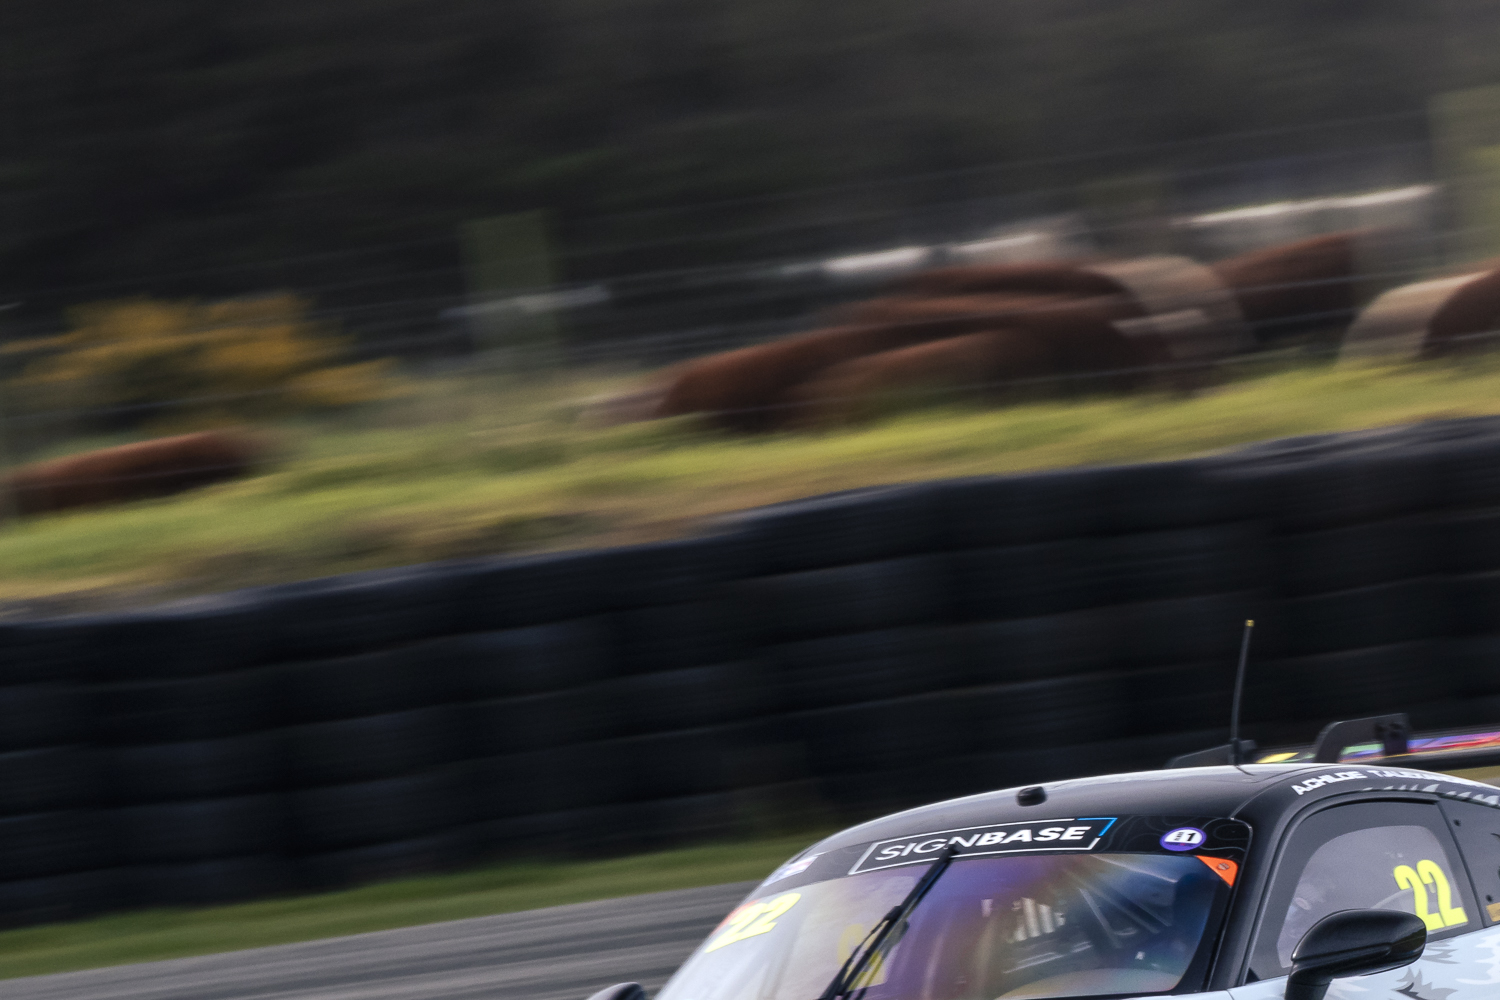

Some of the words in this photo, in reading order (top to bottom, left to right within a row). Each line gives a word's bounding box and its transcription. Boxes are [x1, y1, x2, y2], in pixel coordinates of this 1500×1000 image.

[874, 826, 1092, 861] SIGNBASE
[704, 892, 802, 954] 22
[1393, 859, 1469, 932] 22
